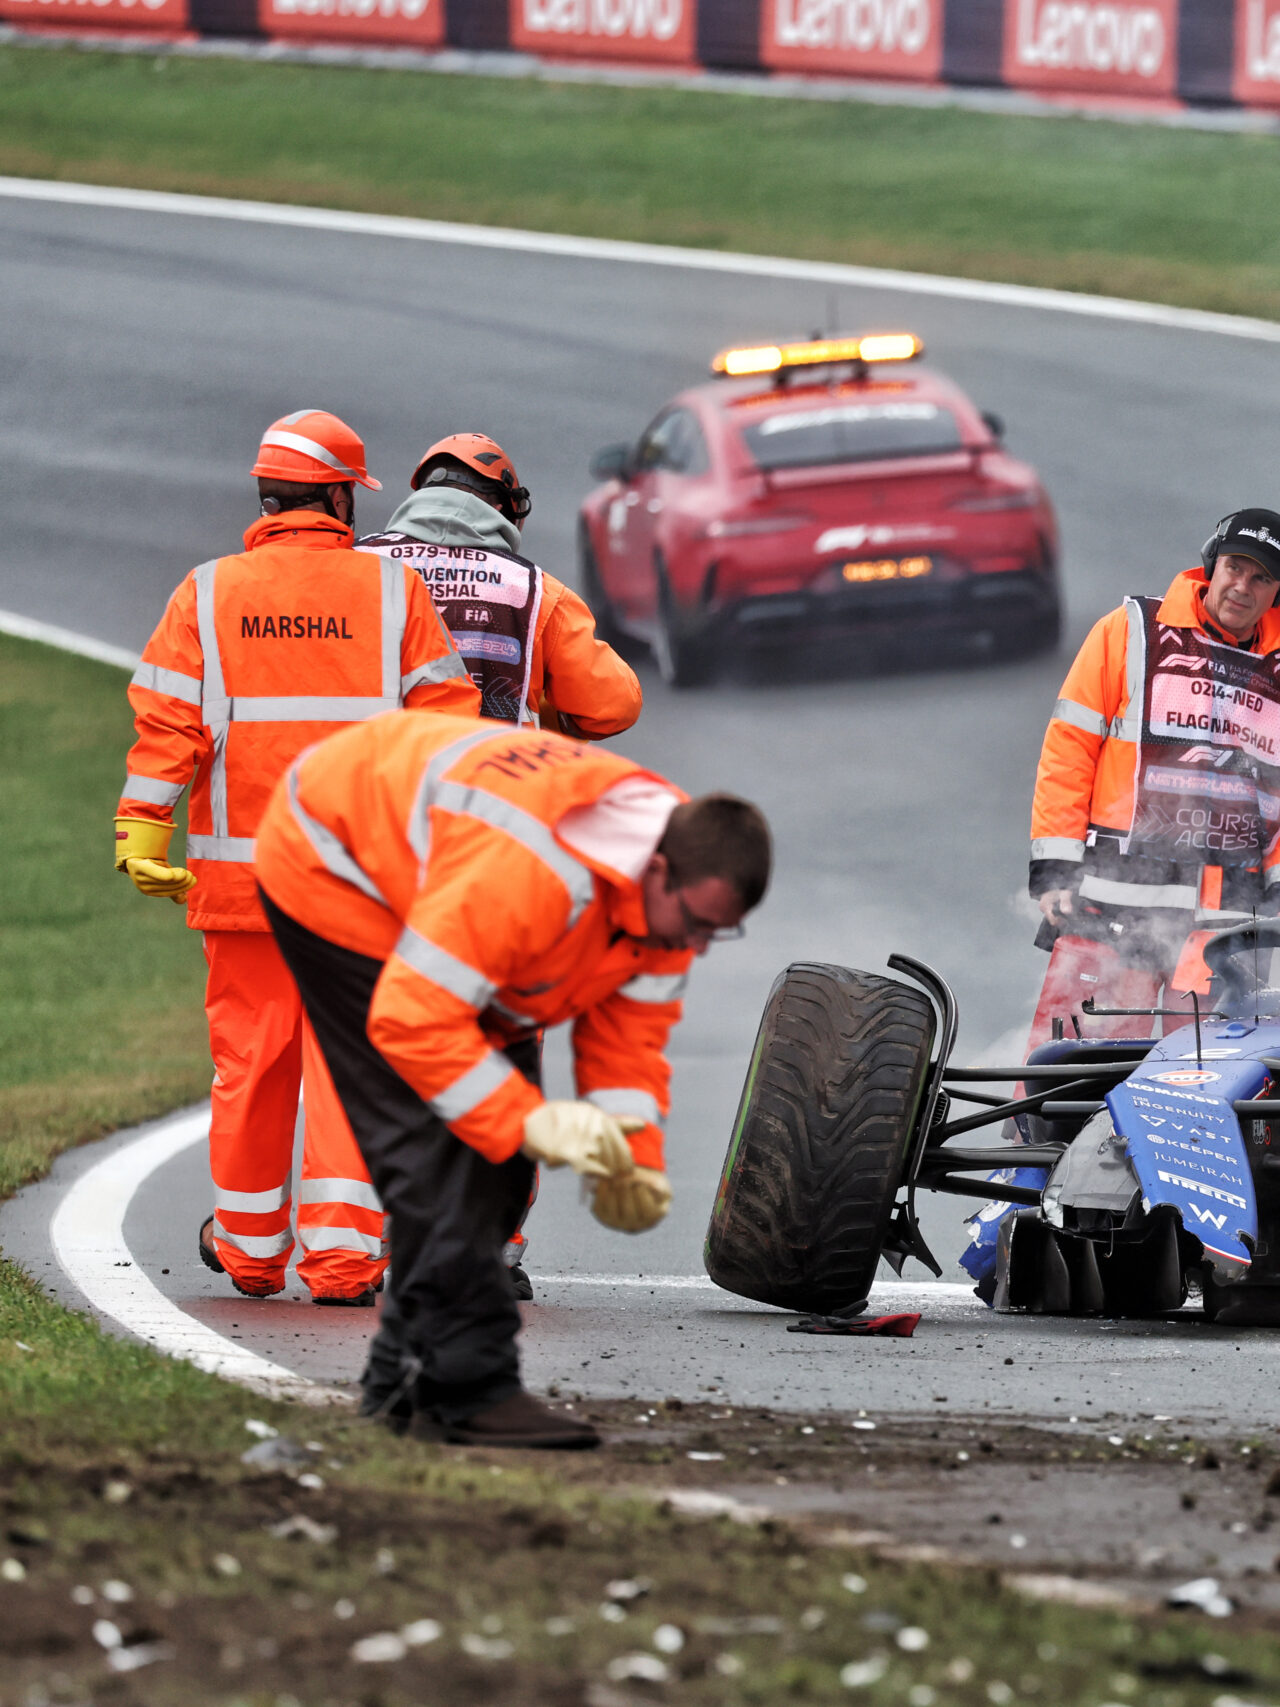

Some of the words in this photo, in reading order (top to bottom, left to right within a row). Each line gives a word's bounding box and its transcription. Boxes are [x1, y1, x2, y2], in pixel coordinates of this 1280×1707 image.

[1017, 0, 1164, 76] Lenovo
[390, 546, 487, 562] 0379-NED
[241, 616, 353, 639] MARSHAL
[1166, 711, 1209, 730] FLAG
[1176, 809, 1261, 831] COURSE
[1175, 830, 1259, 850] ACCESS
[1125, 1081, 1220, 1106] KOMATSU
[1133, 1099, 1225, 1124] INGENUITY
[1171, 1122, 1232, 1144] VAST
[1166, 1138, 1238, 1165] KEEPER
[1154, 1151, 1243, 1185] JUMEIRAH
[1157, 1170, 1247, 1209] PIRELLI
